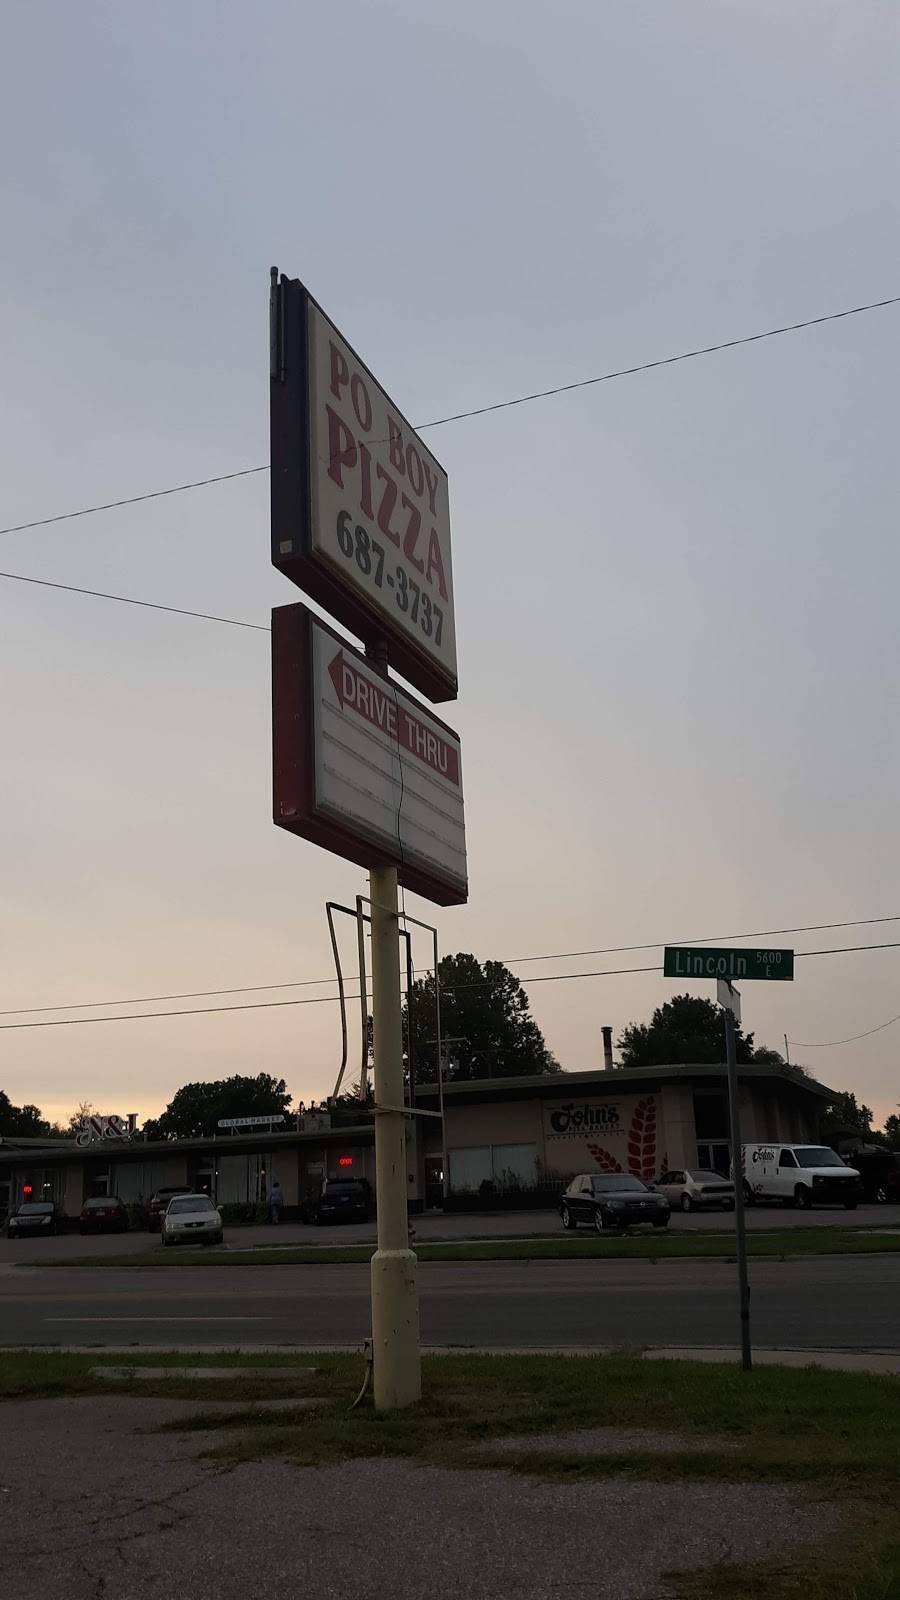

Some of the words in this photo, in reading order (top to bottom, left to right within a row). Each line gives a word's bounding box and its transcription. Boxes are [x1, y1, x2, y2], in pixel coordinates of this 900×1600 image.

[328, 338, 373, 433] PO
[387, 413, 439, 518] BOY
[325, 402, 449, 602] PIZZA
[336, 509, 444, 647] 687-3737
[342, 664, 398, 737] DRIVE
[405, 714, 448, 773] THRU
[675, 951, 747, 975] Lincoln
[756, 951, 782, 964] 5600
[766, 965, 772, 977] E
[550, 1103, 620, 1132] John's
